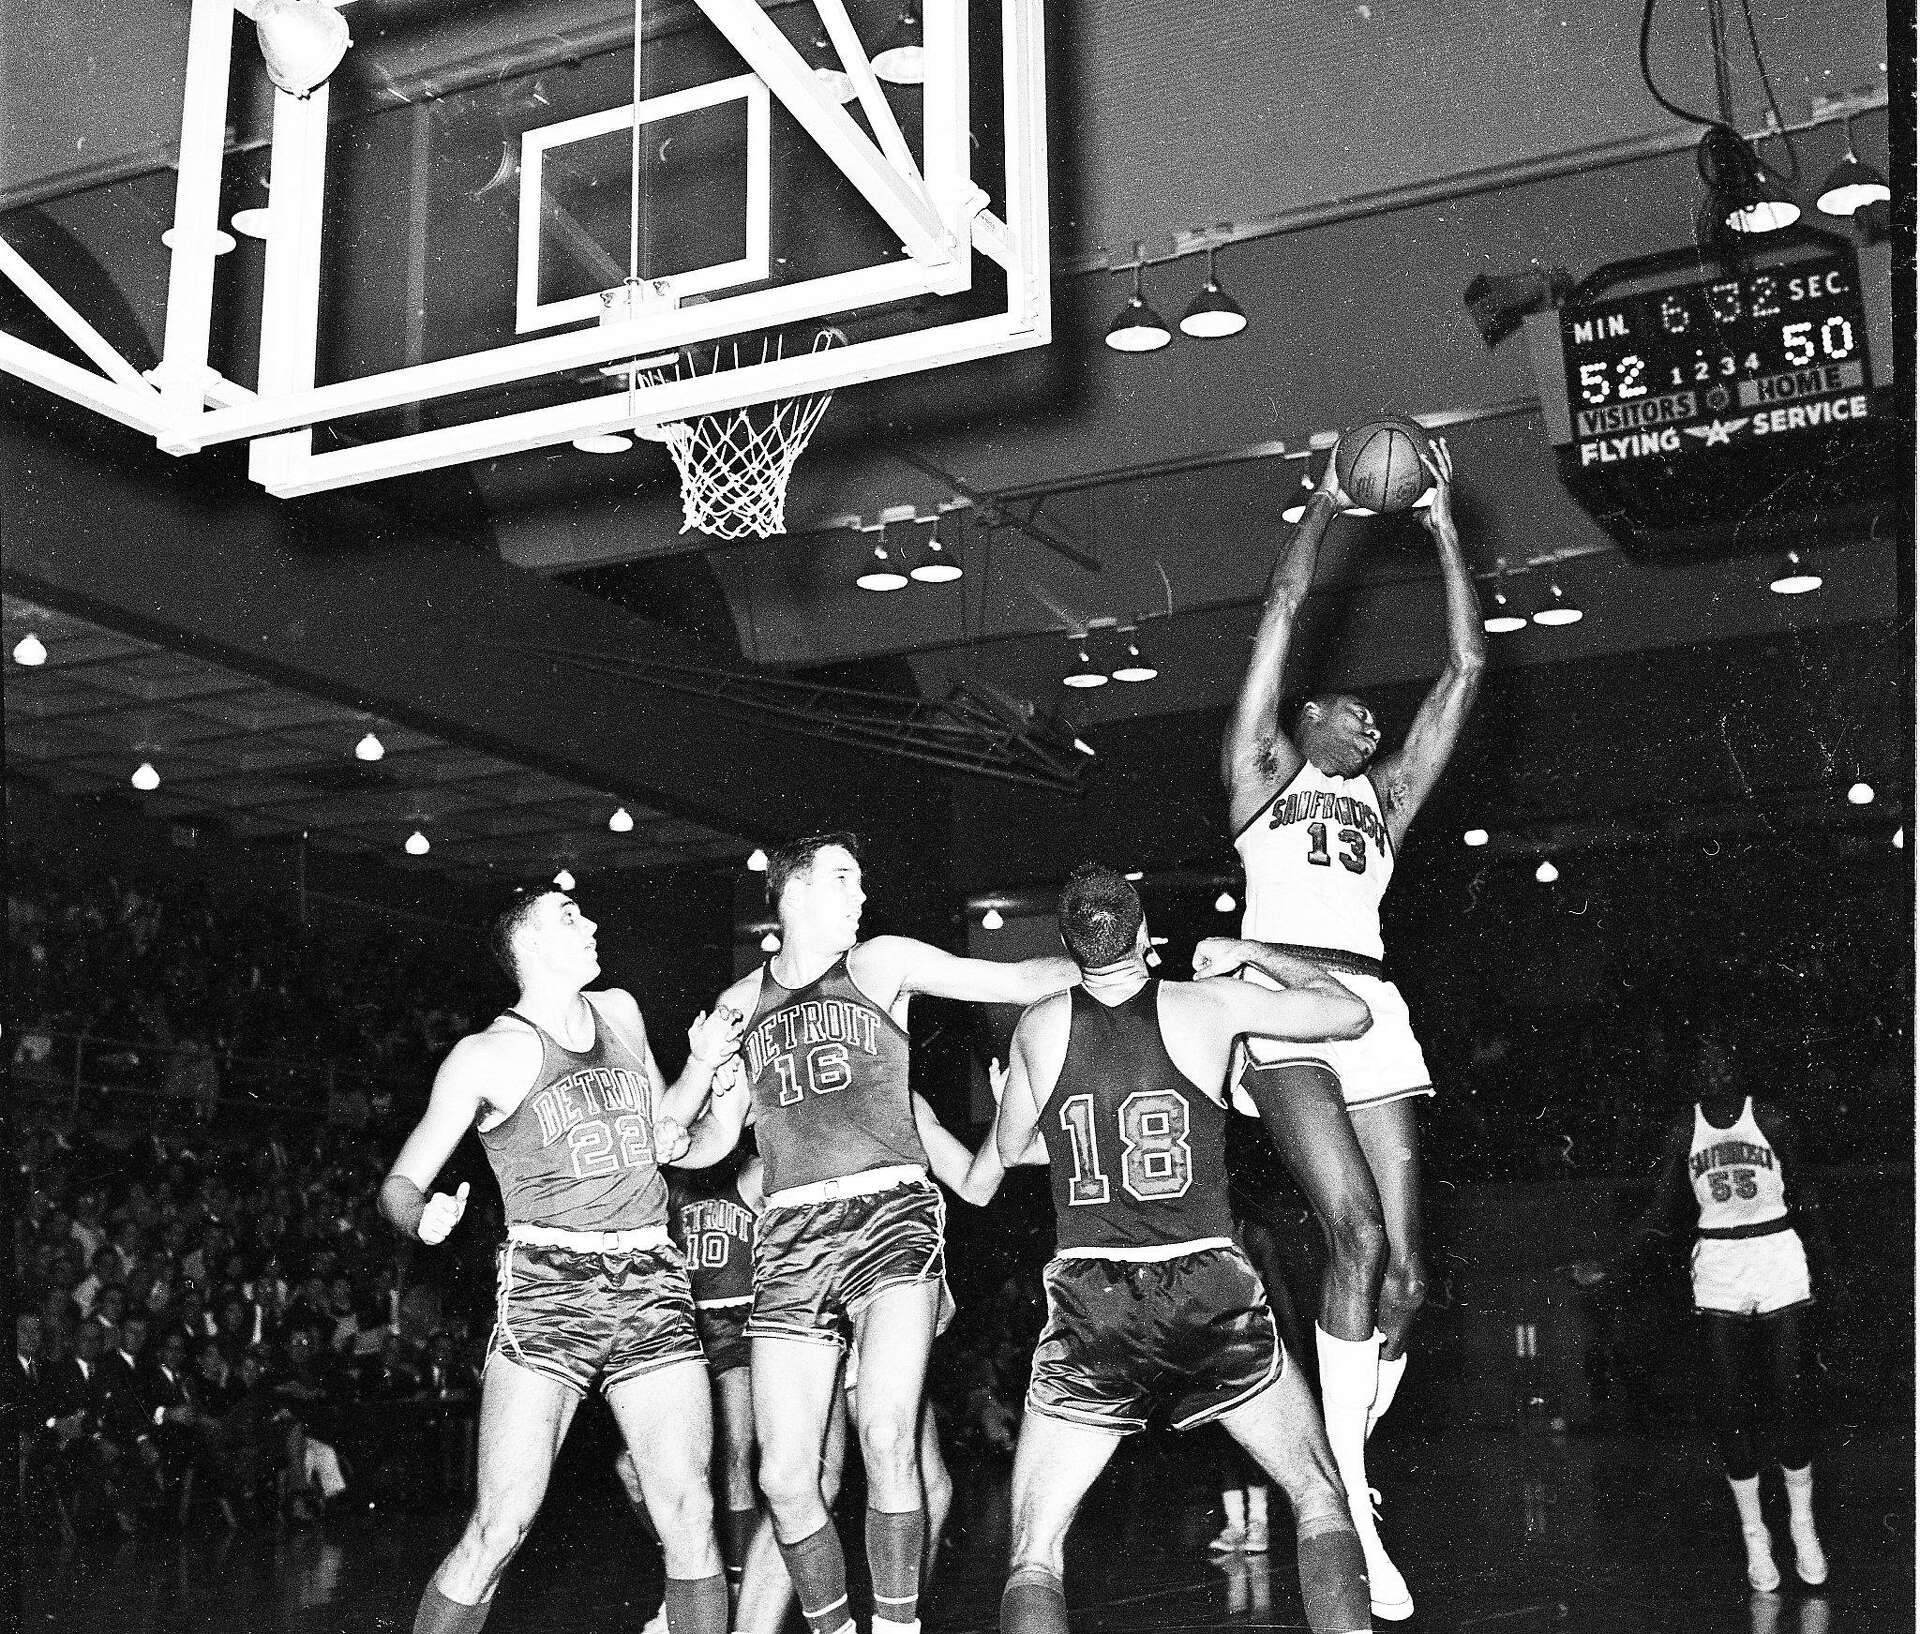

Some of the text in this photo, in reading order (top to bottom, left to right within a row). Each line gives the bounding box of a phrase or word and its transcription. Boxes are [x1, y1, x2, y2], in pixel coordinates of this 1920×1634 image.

[1573, 271, 1849, 343] MIN. 6 32 SEC.
[1580, 315, 1853, 403] 52 1 2 3 4 50
[1757, 364, 1841, 401] HOME
[1580, 394, 1693, 434] VISITORS
[1581, 430, 1680, 466] FLYING
[1753, 396, 1868, 435] SERVICE
[1269, 790, 1312, 830] SAN
[1307, 822, 1366, 875] 13
[745, 1000, 881, 1084] DETROIT
[773, 1042, 852, 1107] 16
[567, 1115, 654, 1179] 22
[1059, 1088, 1193, 1207] 18
[1708, 1168, 1758, 1202] 55
[681, 1199, 753, 1242] ETROIT
[687, 1232, 729, 1269] 10
